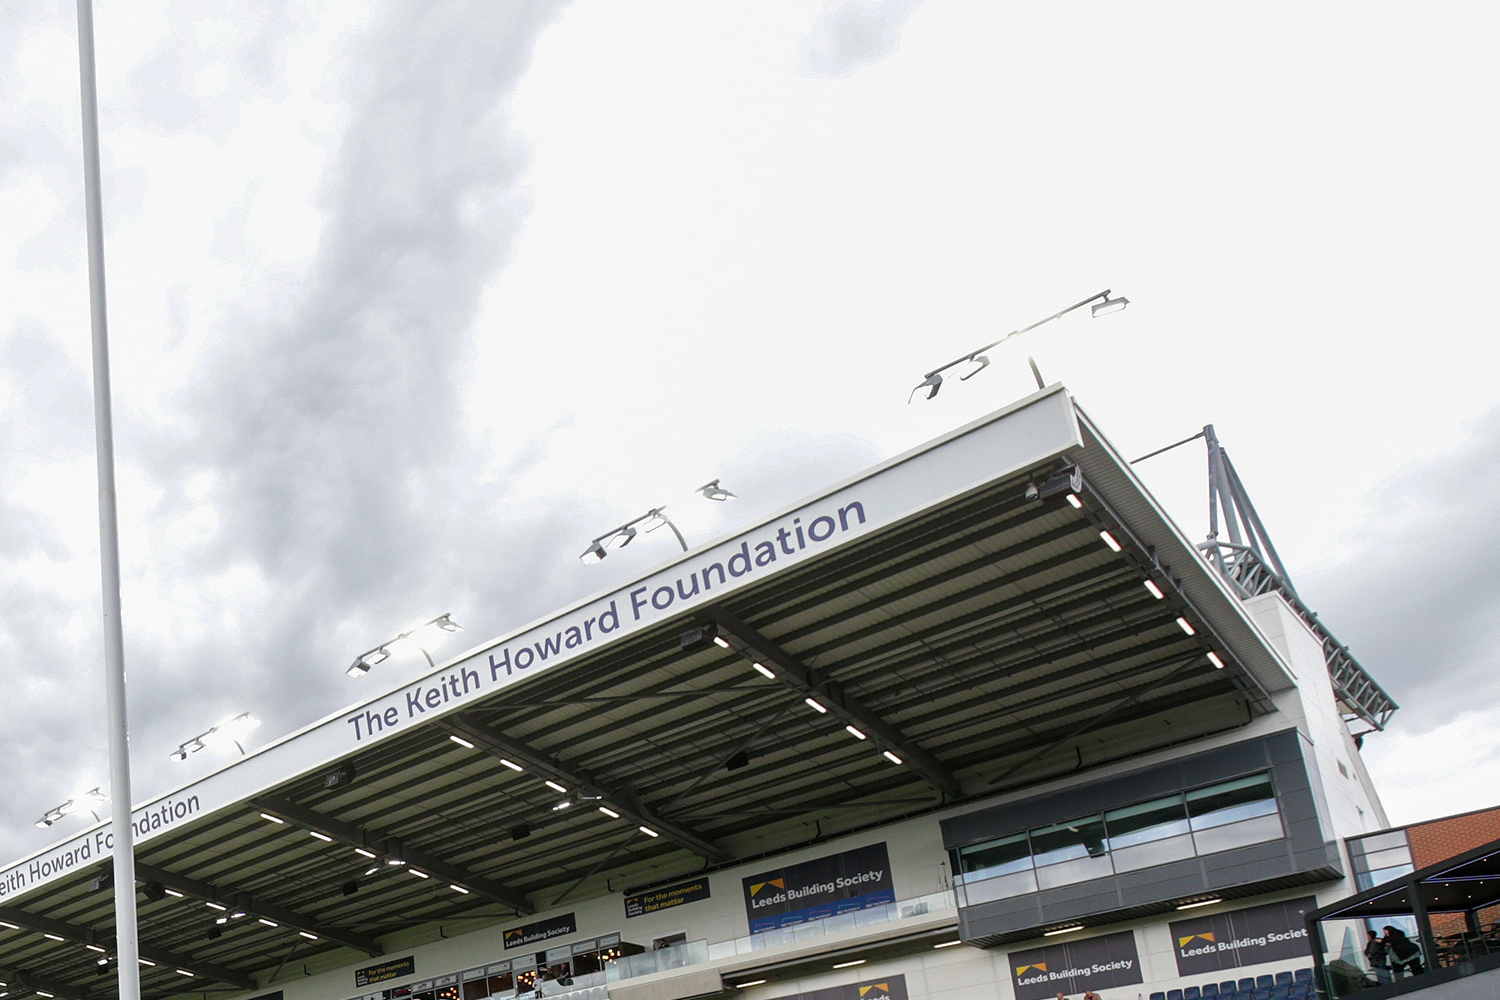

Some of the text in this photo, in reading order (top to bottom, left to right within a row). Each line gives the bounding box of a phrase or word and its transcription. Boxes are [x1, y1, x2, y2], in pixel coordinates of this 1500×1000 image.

[348, 499, 869, 741] The Keith Howard Foundation
[29, 837, 92, 882] Howard
[96, 794, 201, 855] Fondation
[644, 883, 703, 904] For the moments
[644, 896, 684, 912] that matter
[751, 869, 884, 910] Leeds Building Society
[506, 924, 570, 948] Leeds Building Society
[1180, 926, 1309, 959] Leeds Building Societ
[1017, 957, 1134, 987] Leeds Building Society
